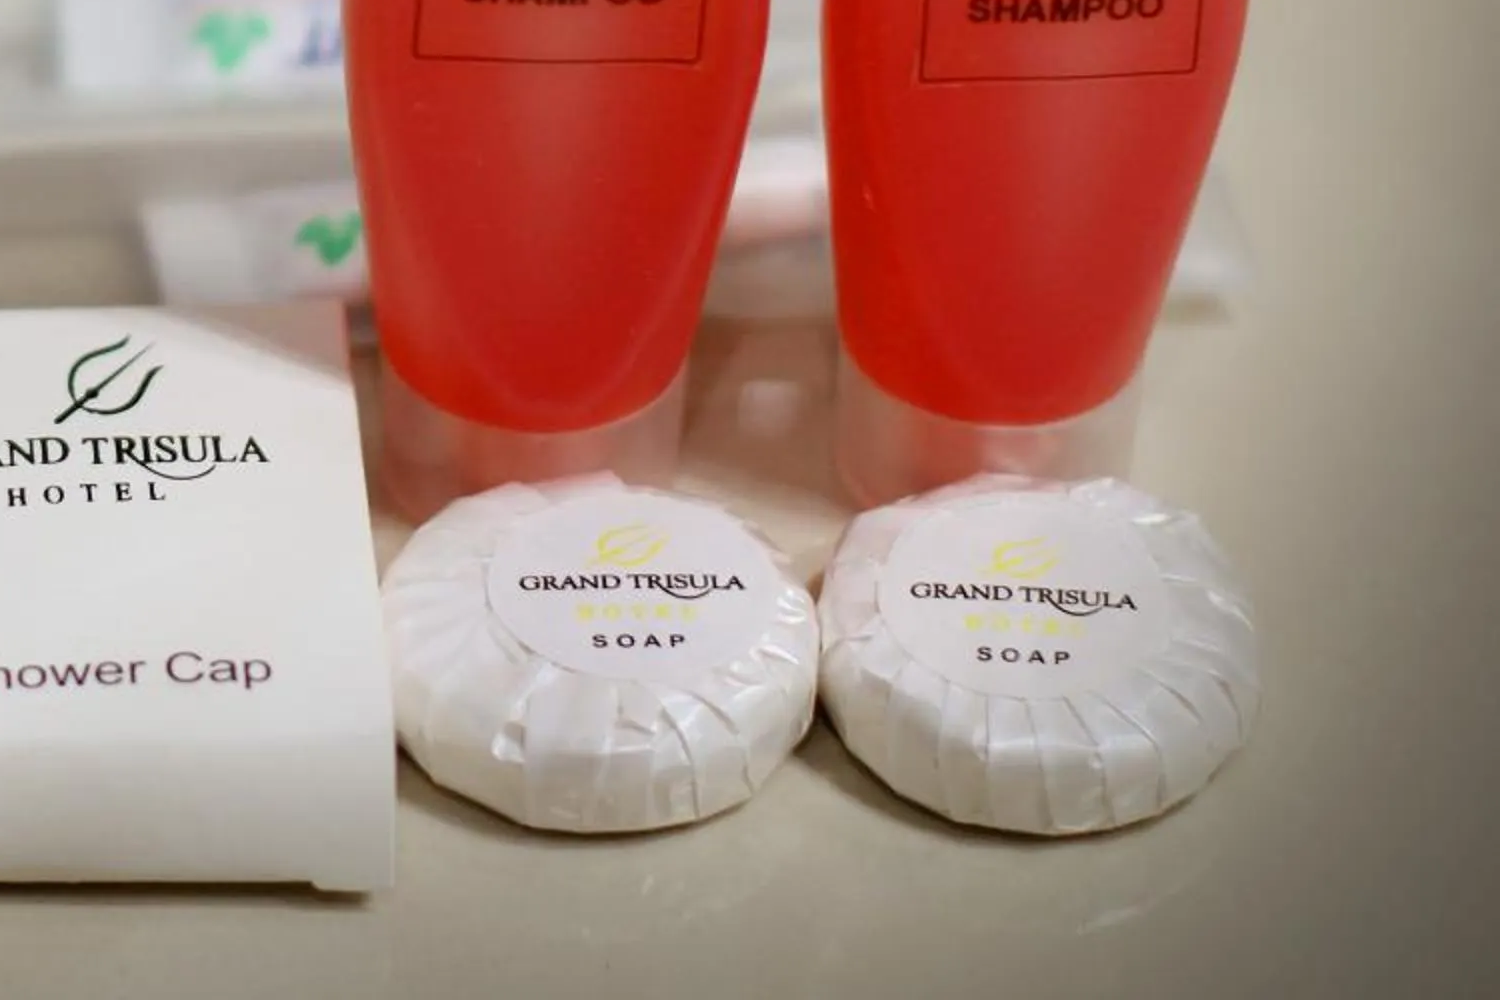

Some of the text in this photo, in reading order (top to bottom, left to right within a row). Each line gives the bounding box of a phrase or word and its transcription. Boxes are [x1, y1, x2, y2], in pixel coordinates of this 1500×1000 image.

[82, 435, 269, 480] TRISULA
[7, 482, 166, 507] HOTEL
[519, 573, 745, 599] GRAND TRISULA
[910, 582, 1137, 616] GRAND TRISULA
[591, 633, 686, 648] SOAP
[977, 646, 1071, 664] SOAP
[165, 651, 272, 689] Cap
